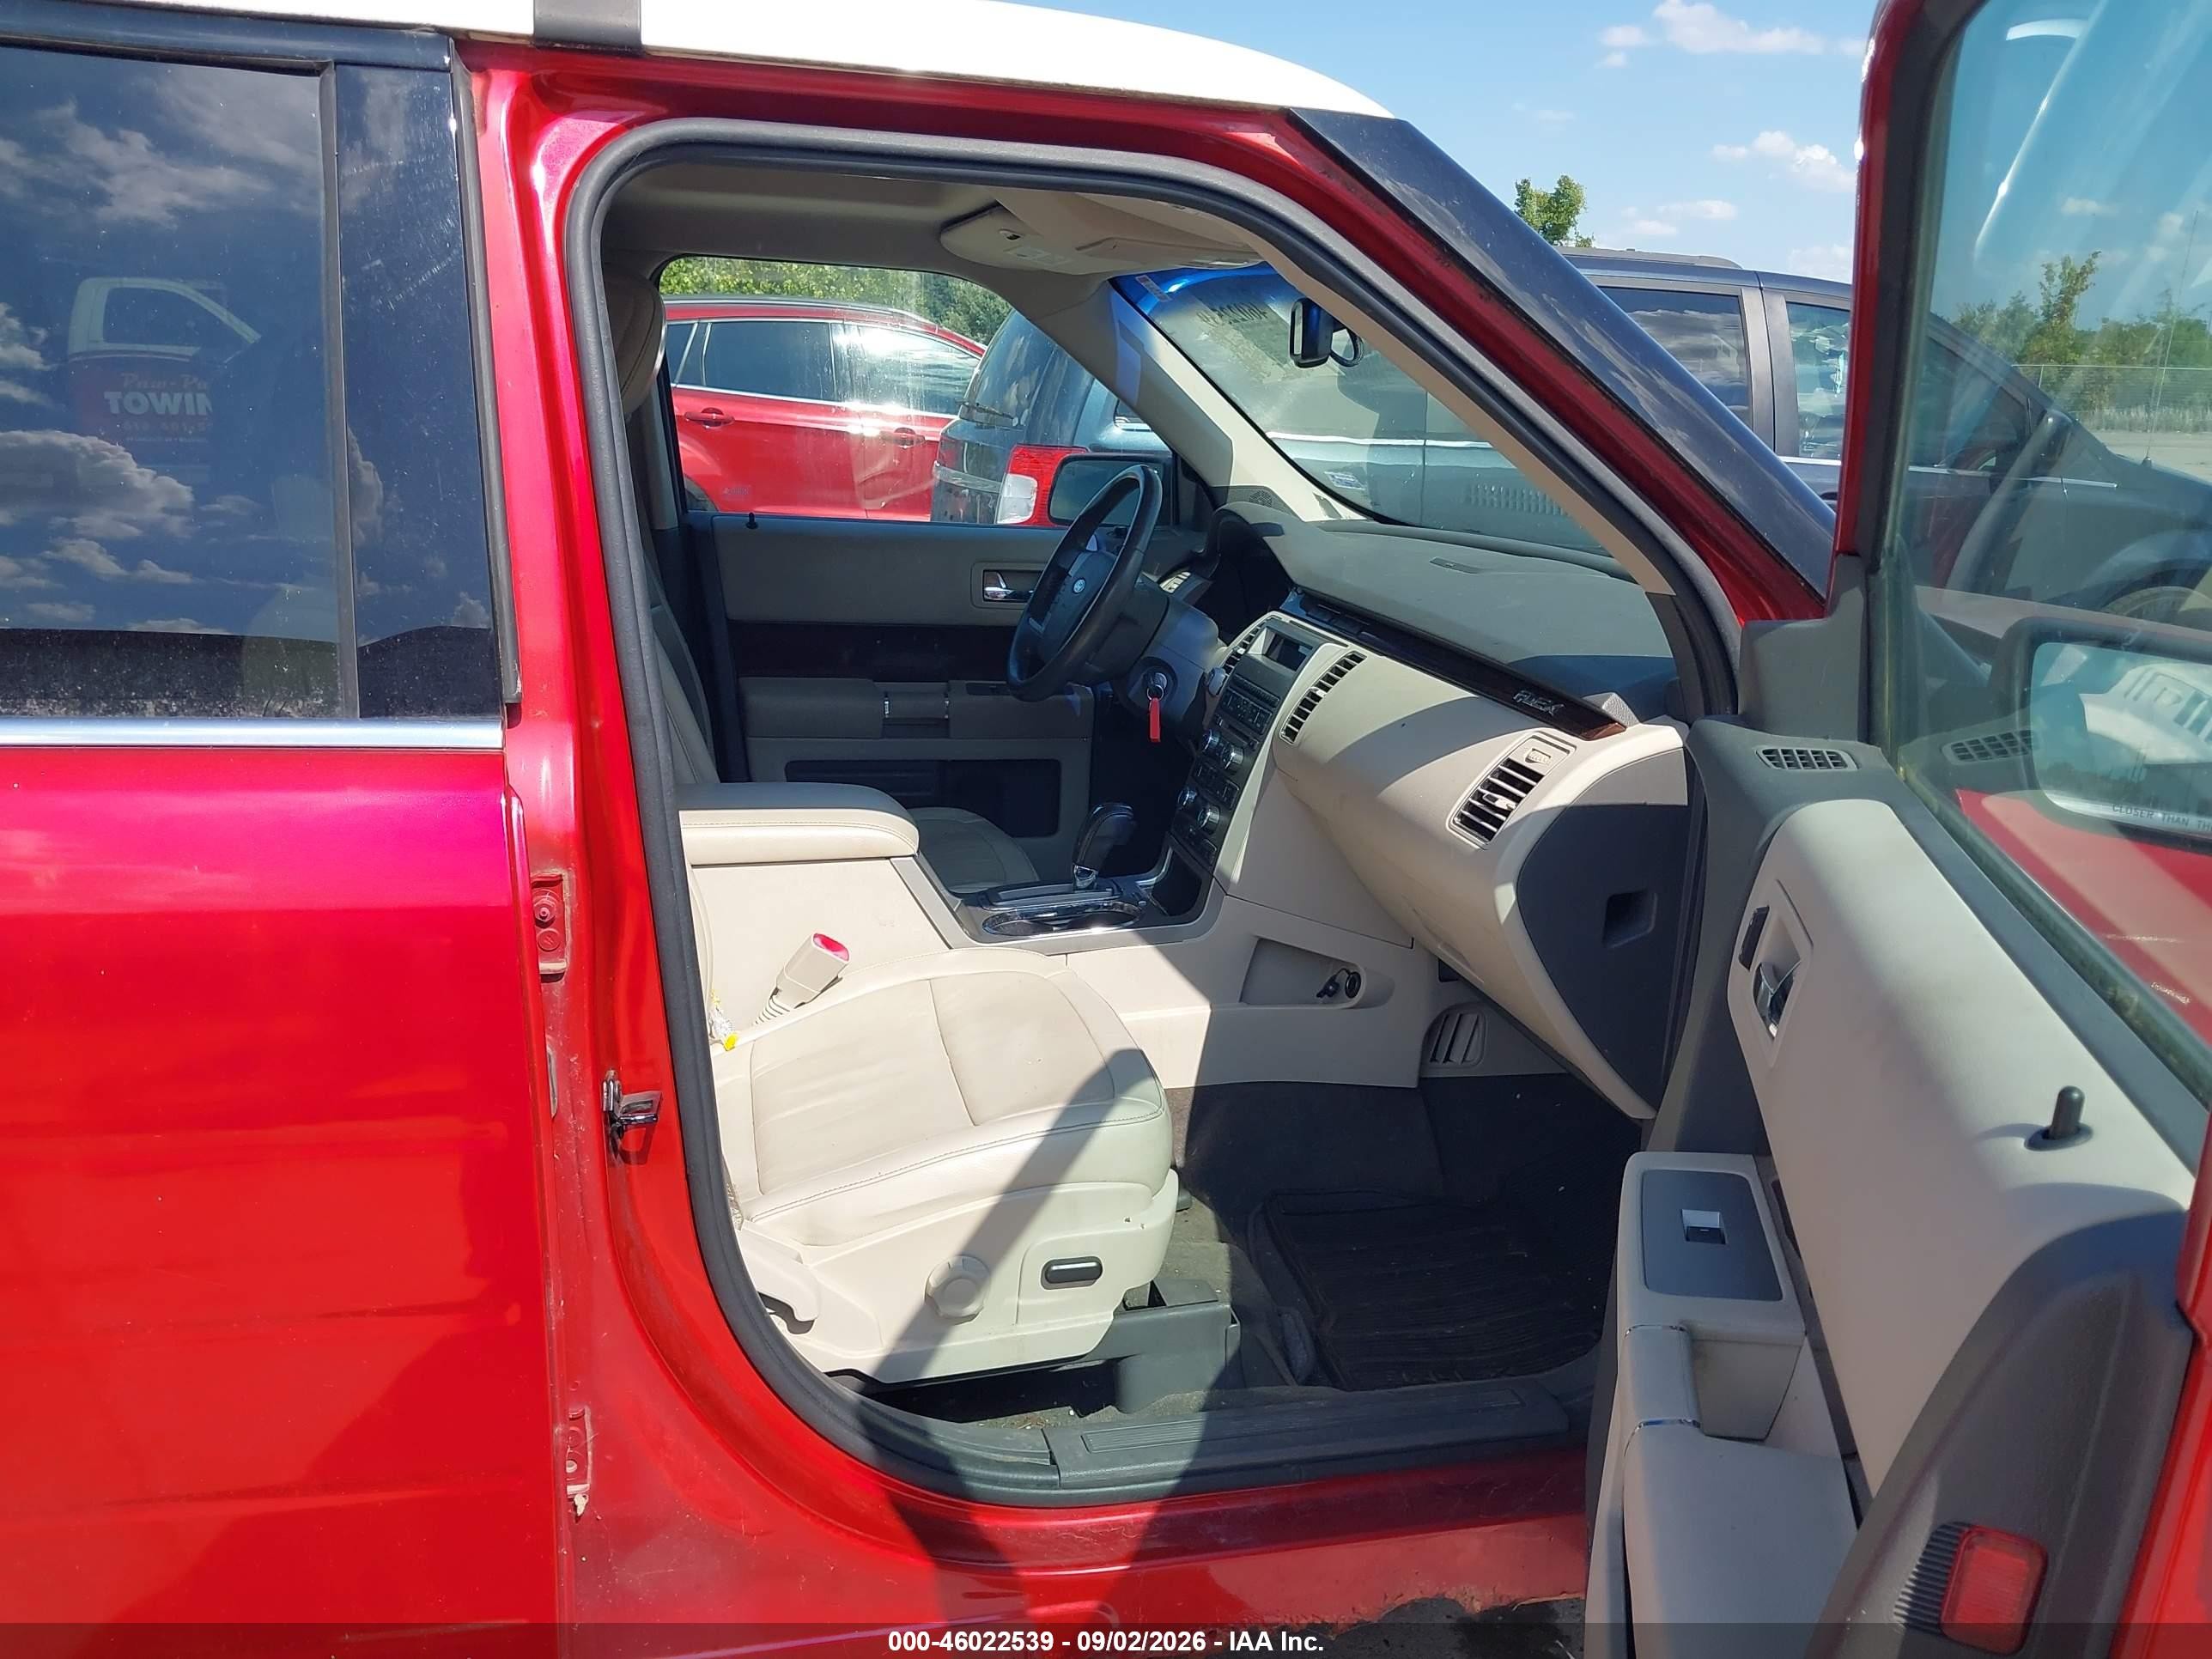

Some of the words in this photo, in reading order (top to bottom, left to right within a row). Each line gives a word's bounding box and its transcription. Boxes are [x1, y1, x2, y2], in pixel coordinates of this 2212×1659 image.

[1512, 690, 1565, 717] FLEX
[2112, 803, 2154, 819] CLOSER
[2162, 811, 2190, 827] THAN
[2197, 819, 2212, 832] TH
